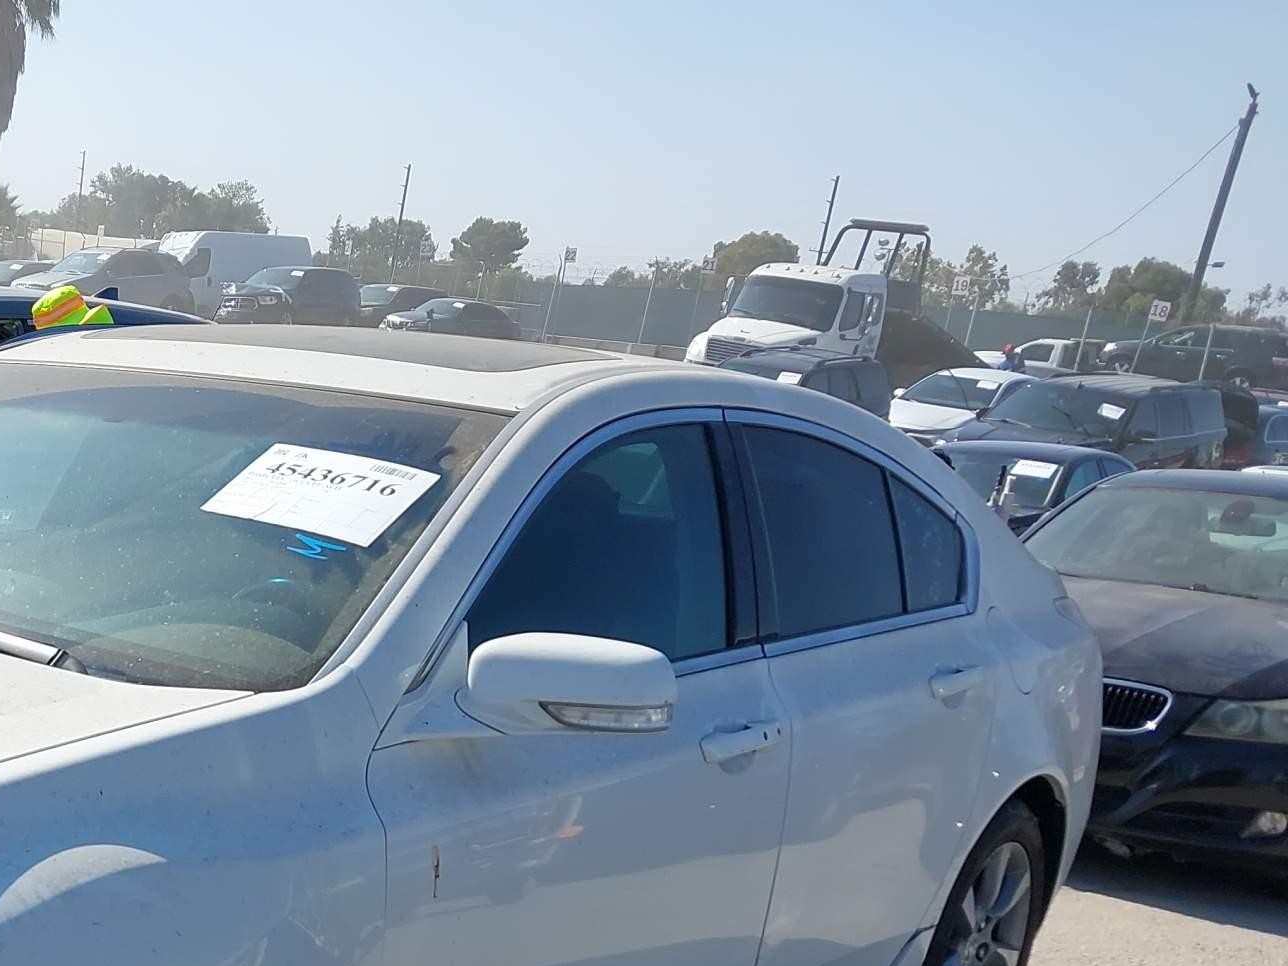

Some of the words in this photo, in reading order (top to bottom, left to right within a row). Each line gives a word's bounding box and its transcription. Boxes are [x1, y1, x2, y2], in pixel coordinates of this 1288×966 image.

[565, 250, 577, 261] 22
[702, 260, 715, 271] 21
[953, 279, 968, 292] 19
[1150, 304, 1168, 318] 18
[266, 461, 404, 497] 45436716
